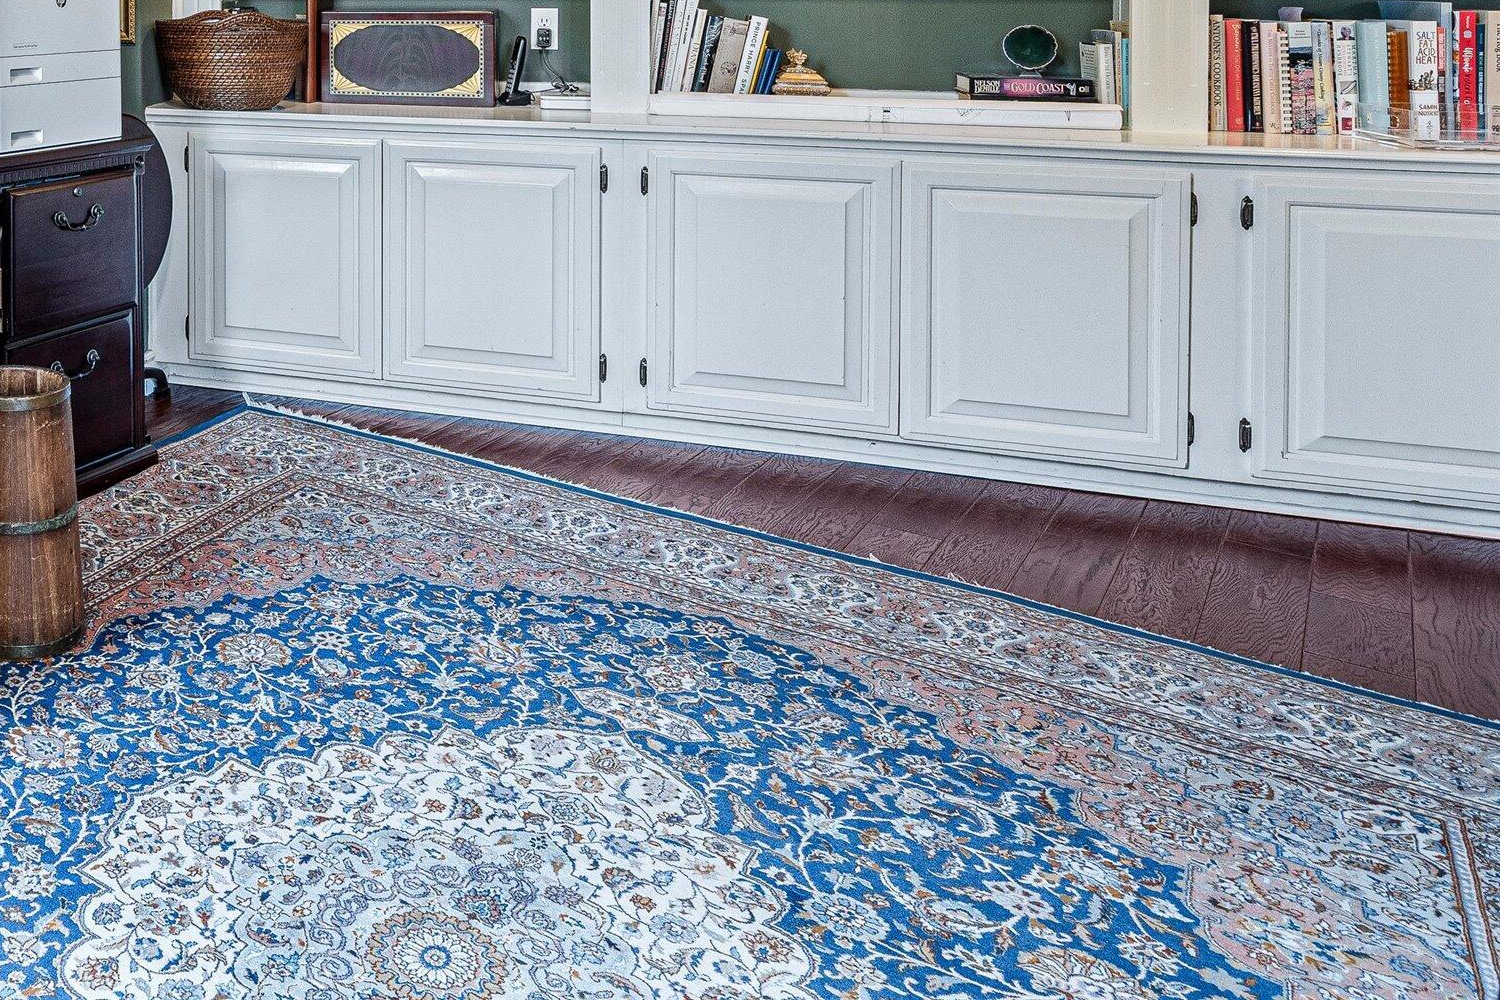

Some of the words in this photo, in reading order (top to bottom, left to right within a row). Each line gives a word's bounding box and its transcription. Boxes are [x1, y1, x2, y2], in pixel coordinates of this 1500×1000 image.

[750, 22, 761, 48] PRINCE
[1213, 20, 1221, 60] ANTOINE'S
[1419, 40, 1433, 48] FAT
[688, 42, 700, 69] DIANA
[744, 50, 754, 75] HARRY
[1416, 56, 1436, 64] HEAT
[1417, 48, 1435, 56] ACID
[1011, 81, 1034, 93] GOLD
[1036, 81, 1065, 94] COAST
[1213, 62, 1221, 106] COOKBOOK
